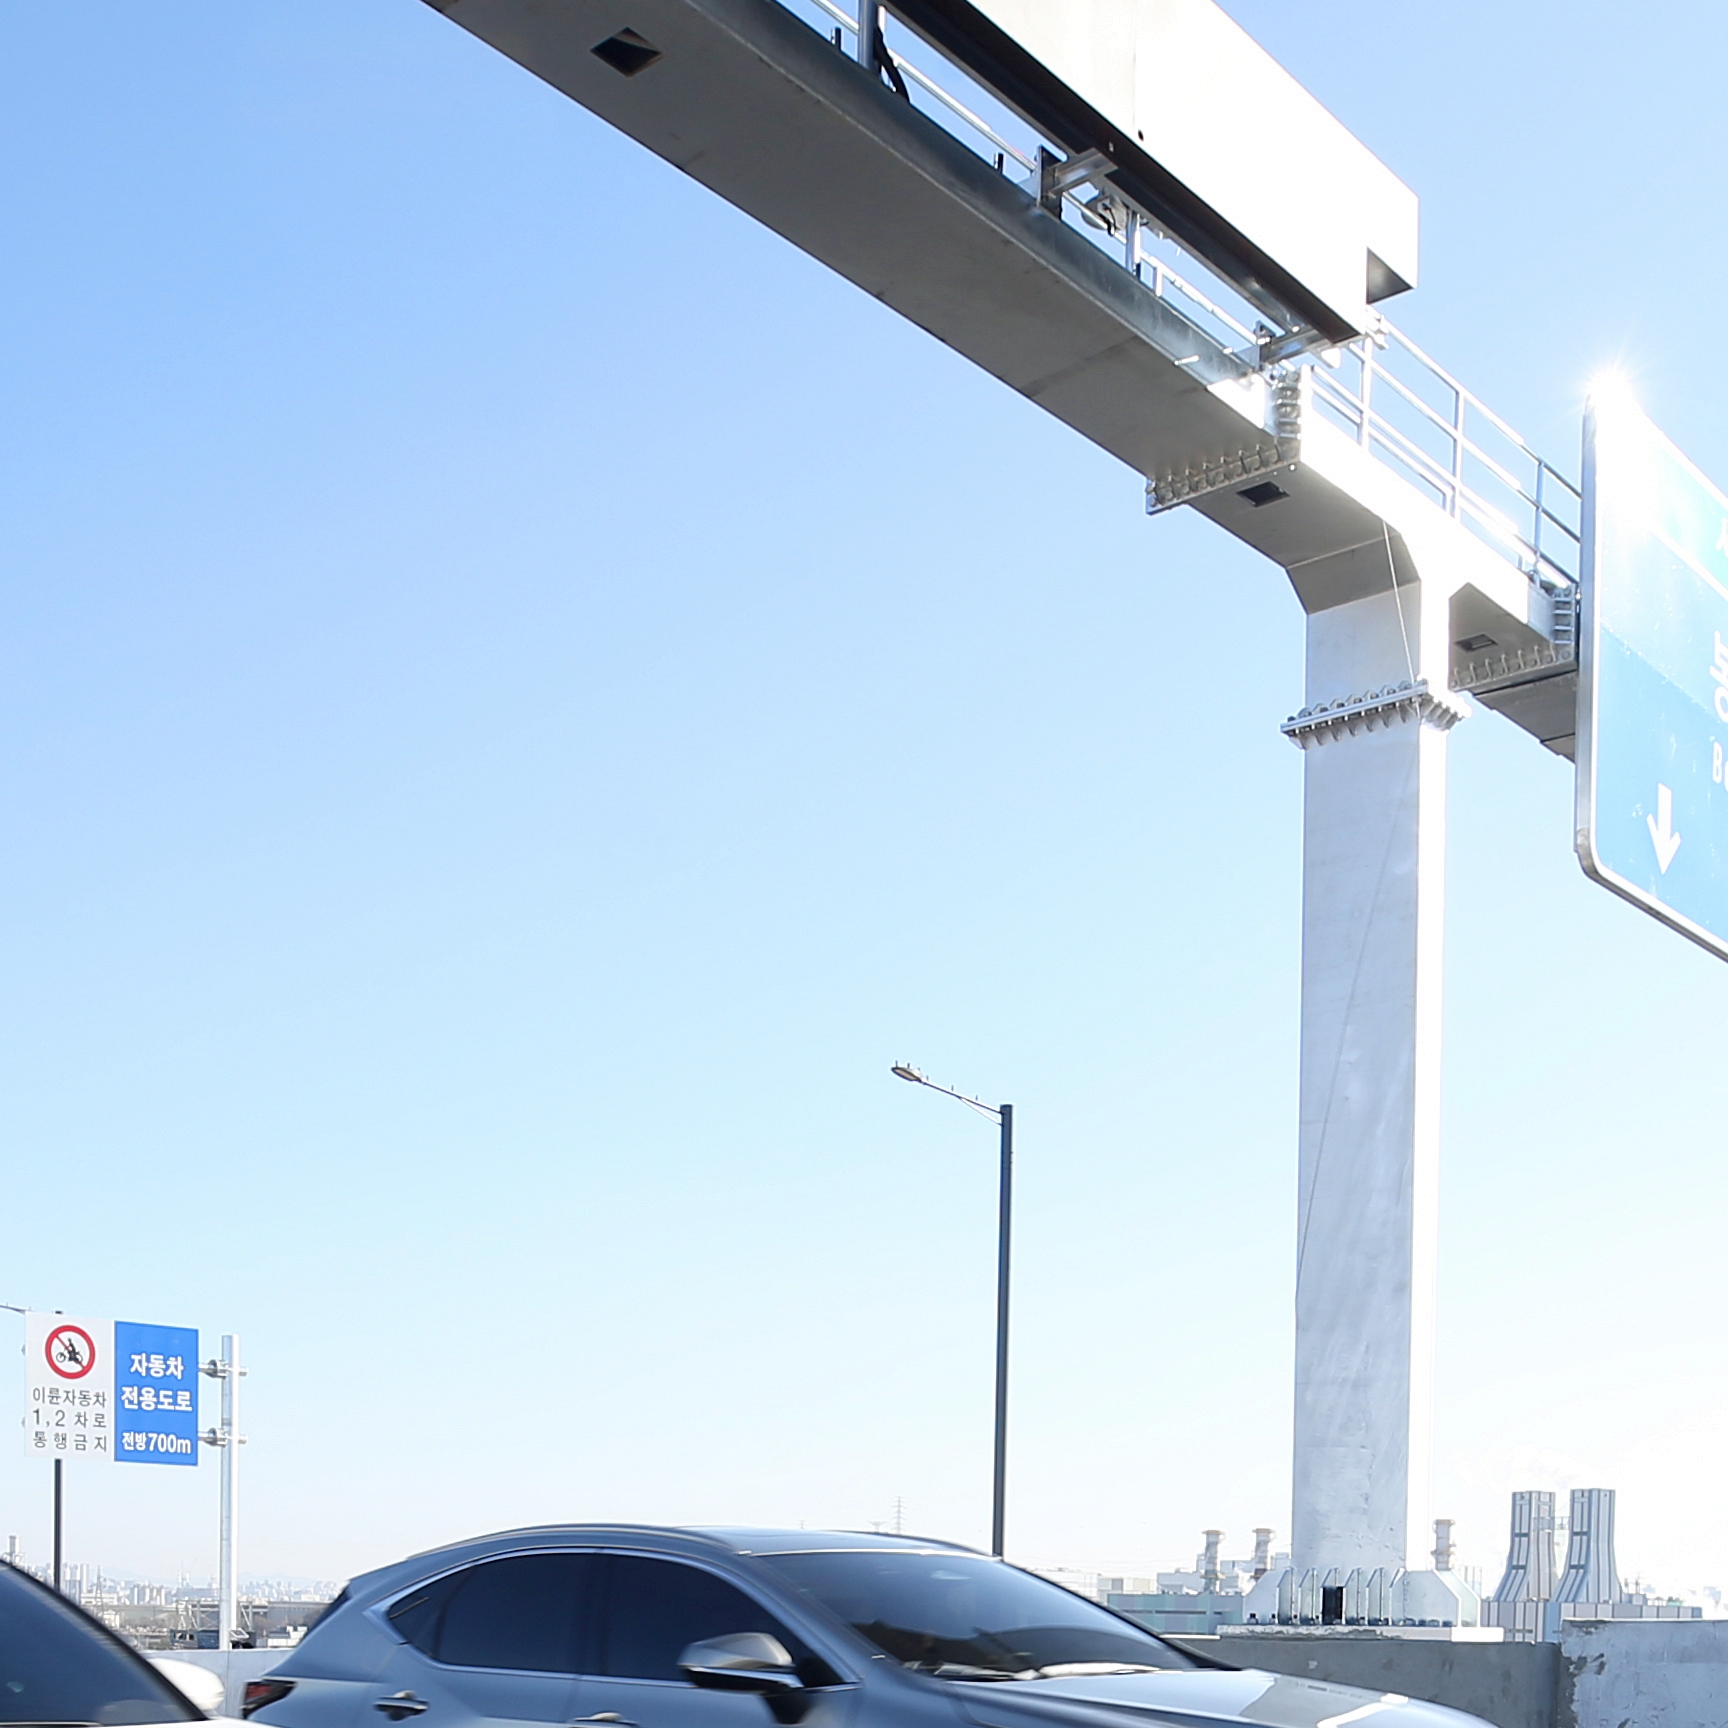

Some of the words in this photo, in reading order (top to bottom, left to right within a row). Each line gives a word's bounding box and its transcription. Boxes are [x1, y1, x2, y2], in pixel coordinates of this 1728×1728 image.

[130, 1353, 184, 1379] 자동차
[32, 1386, 107, 1408] 이륜자동차
[121, 1385, 193, 1412] 전용도로
